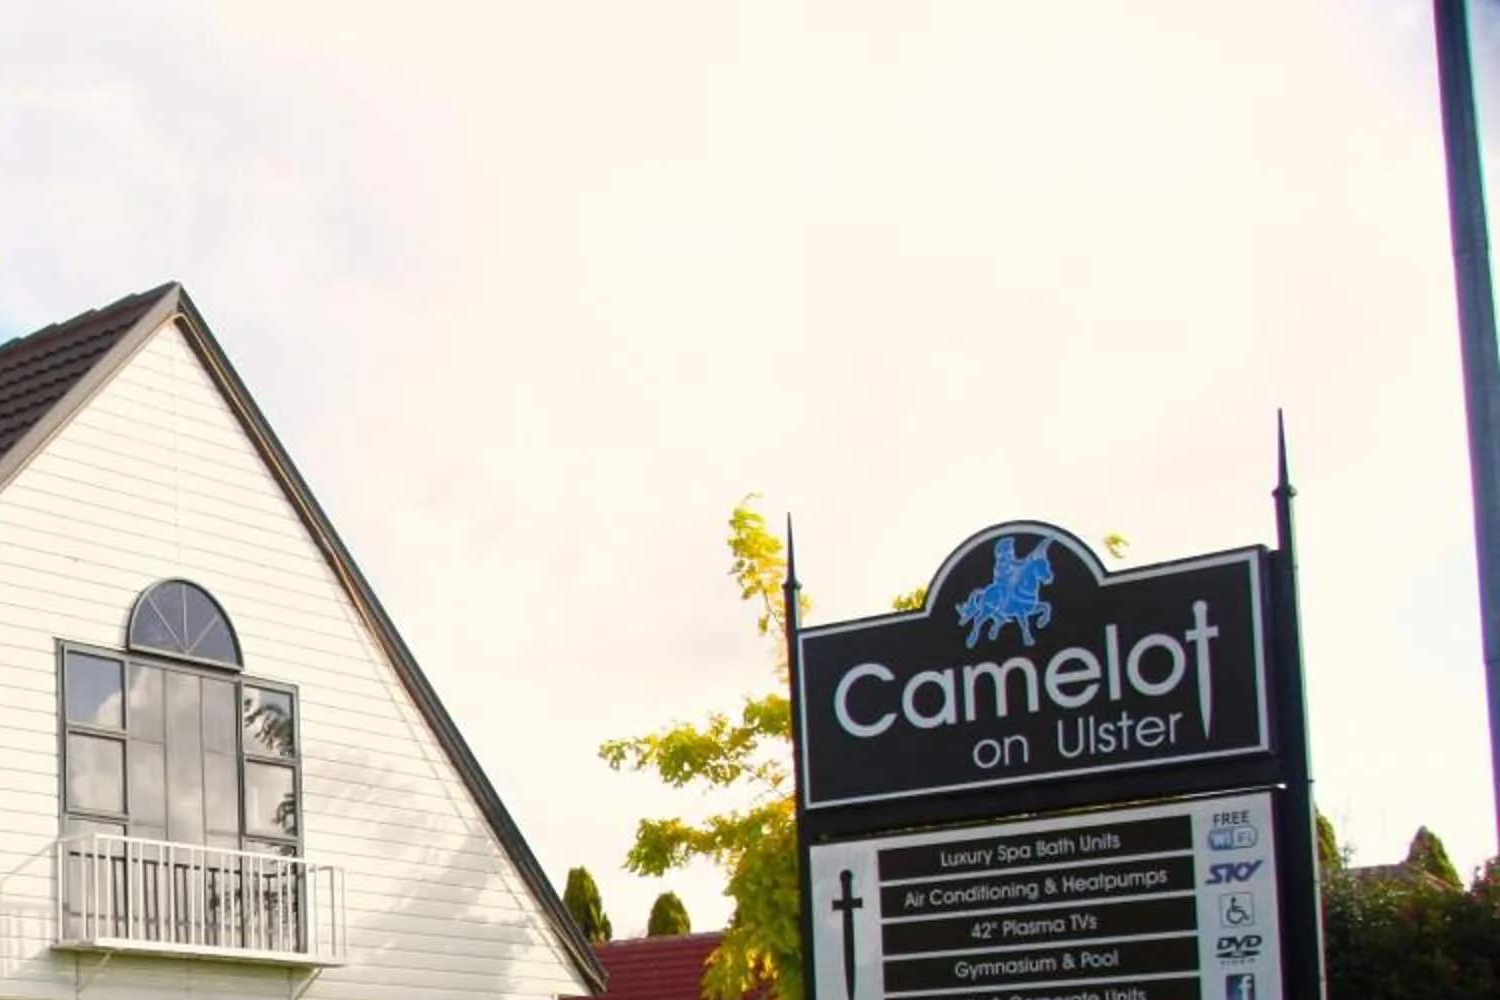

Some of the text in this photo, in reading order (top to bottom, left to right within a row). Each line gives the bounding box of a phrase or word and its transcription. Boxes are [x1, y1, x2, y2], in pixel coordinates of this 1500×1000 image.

[834, 600, 1219, 739] Camelot
[973, 711, 1184, 768] on Ulster
[1213, 810, 1250, 826] FREE
[940, 833, 1121, 867] Luxury Spa Bath Units
[1205, 860, 1264, 885] SKY
[904, 868, 1168, 909] Air Conditioning & Heatpumps
[1002, 918, 1065, 937] Plasma
[1216, 934, 1262, 950] DVD
[954, 950, 1119, 980] Gymnasium & Pool
